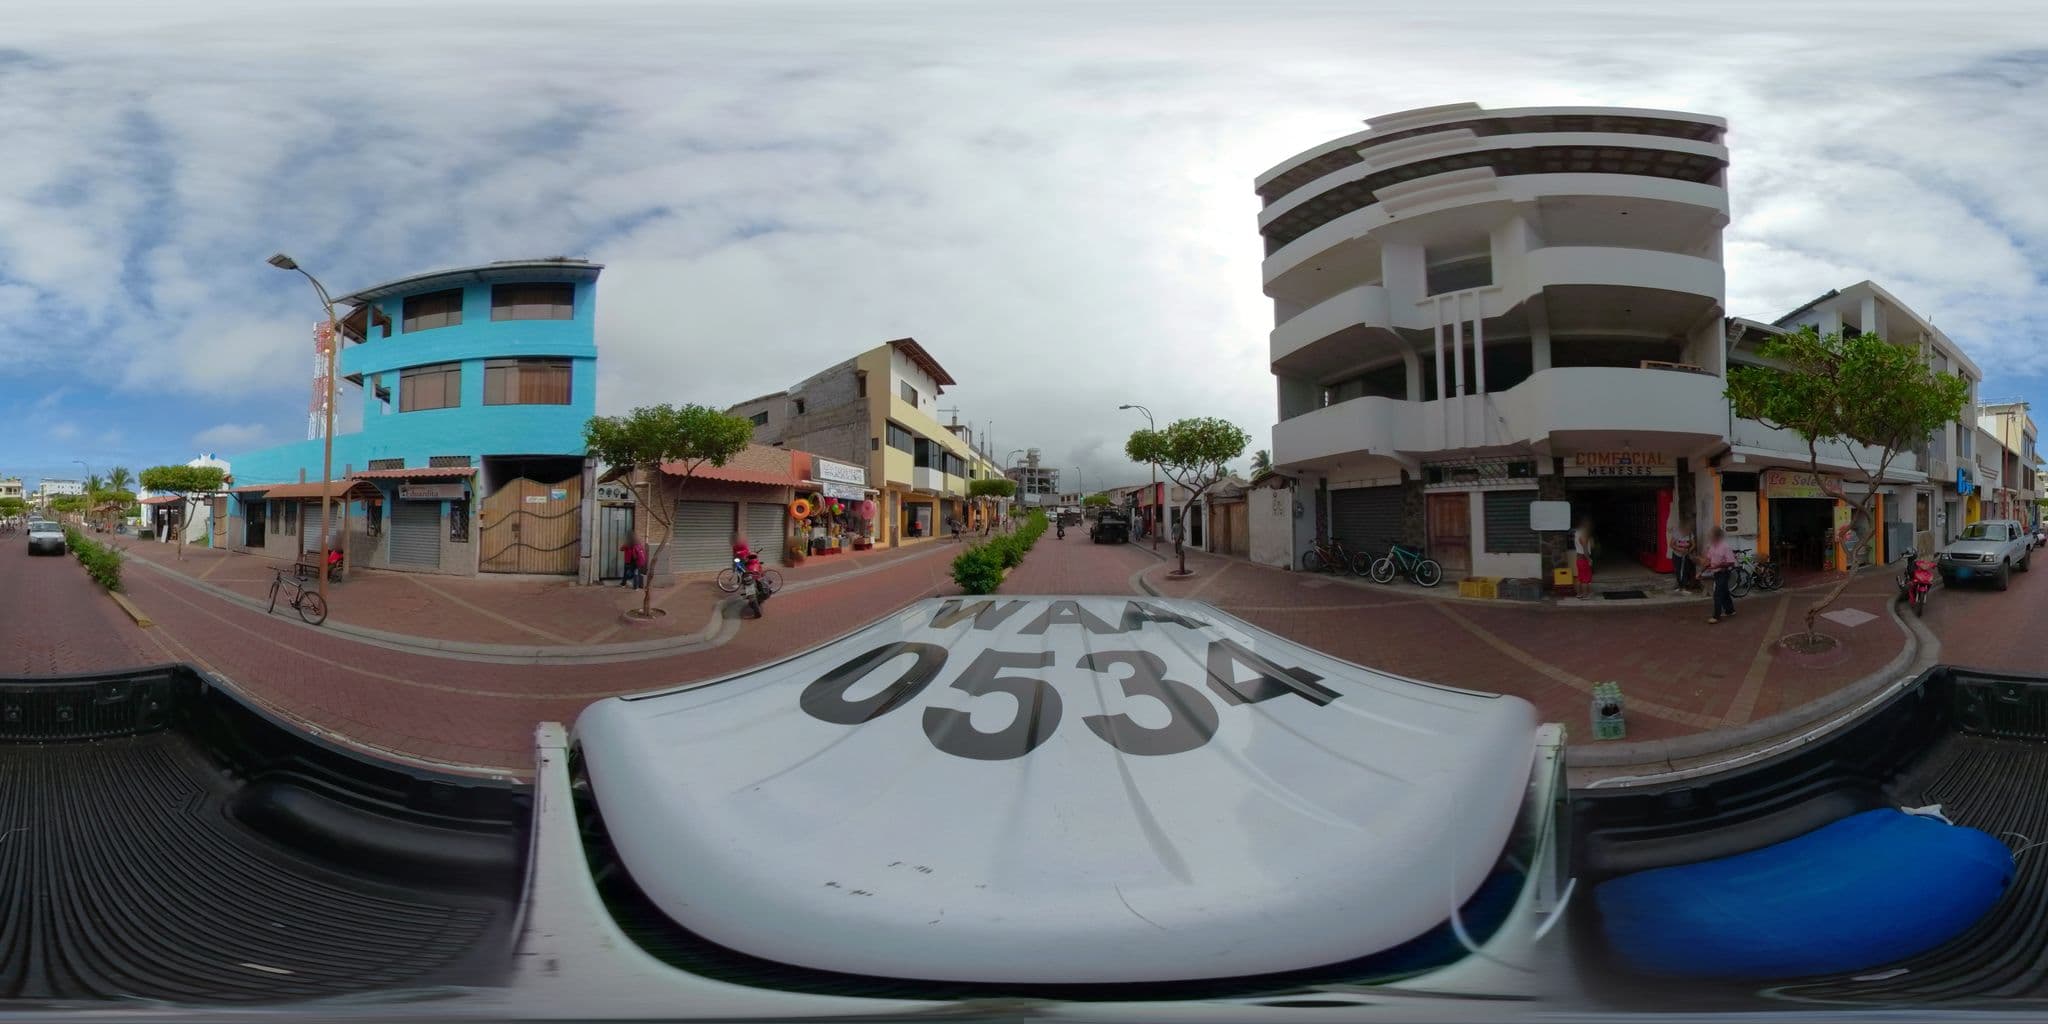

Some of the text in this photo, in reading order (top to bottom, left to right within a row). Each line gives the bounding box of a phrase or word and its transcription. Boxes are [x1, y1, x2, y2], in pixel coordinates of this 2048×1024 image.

[1587, 466, 1652, 476] MENESES
[1767, 472, 1786, 486] La
[928, 599, 1212, 635] WAA
[799, 640, 1345, 761] 0534
